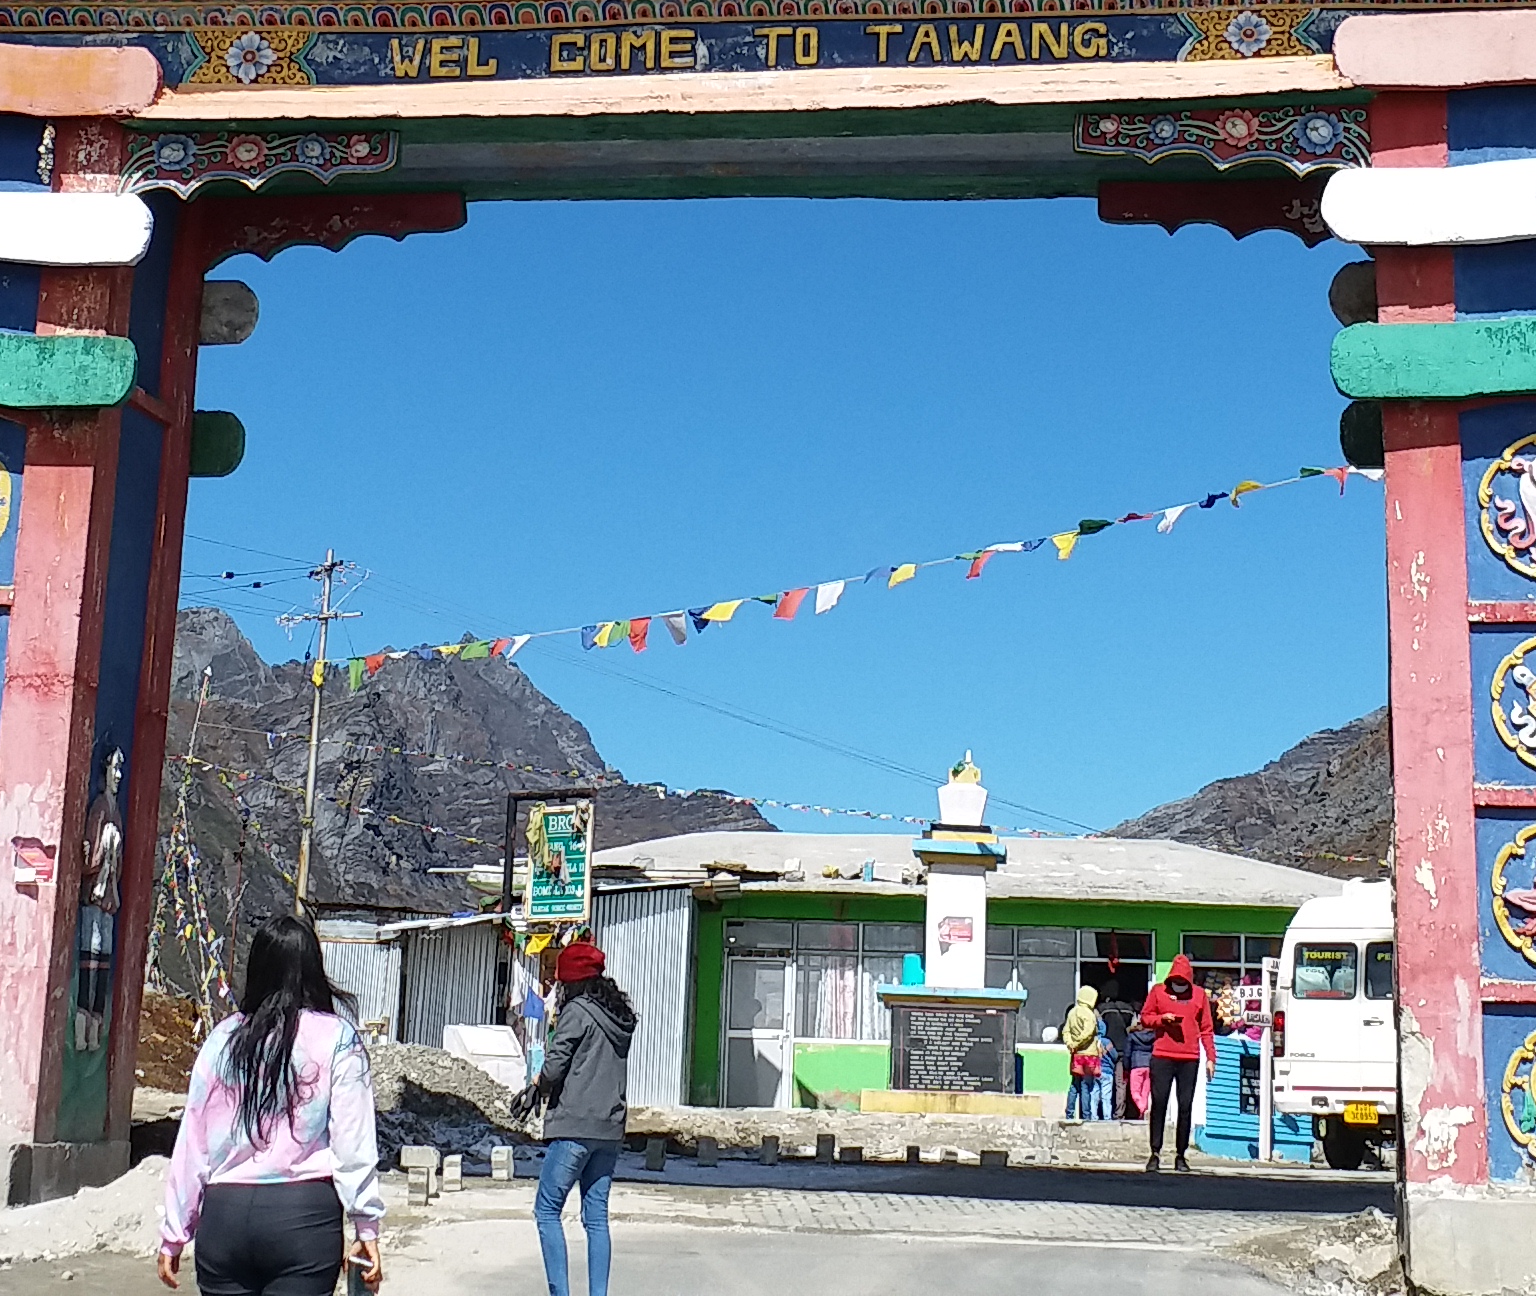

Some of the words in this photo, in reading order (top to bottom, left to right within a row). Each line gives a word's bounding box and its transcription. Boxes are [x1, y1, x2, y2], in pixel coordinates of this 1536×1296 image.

[390, 37, 497, 78] WEL
[549, 29, 696, 71] COME
[754, 26, 818, 66] TO
[866, 22, 1108, 62] TAWANG
[1304, 951, 1349, 960] TOURIST
